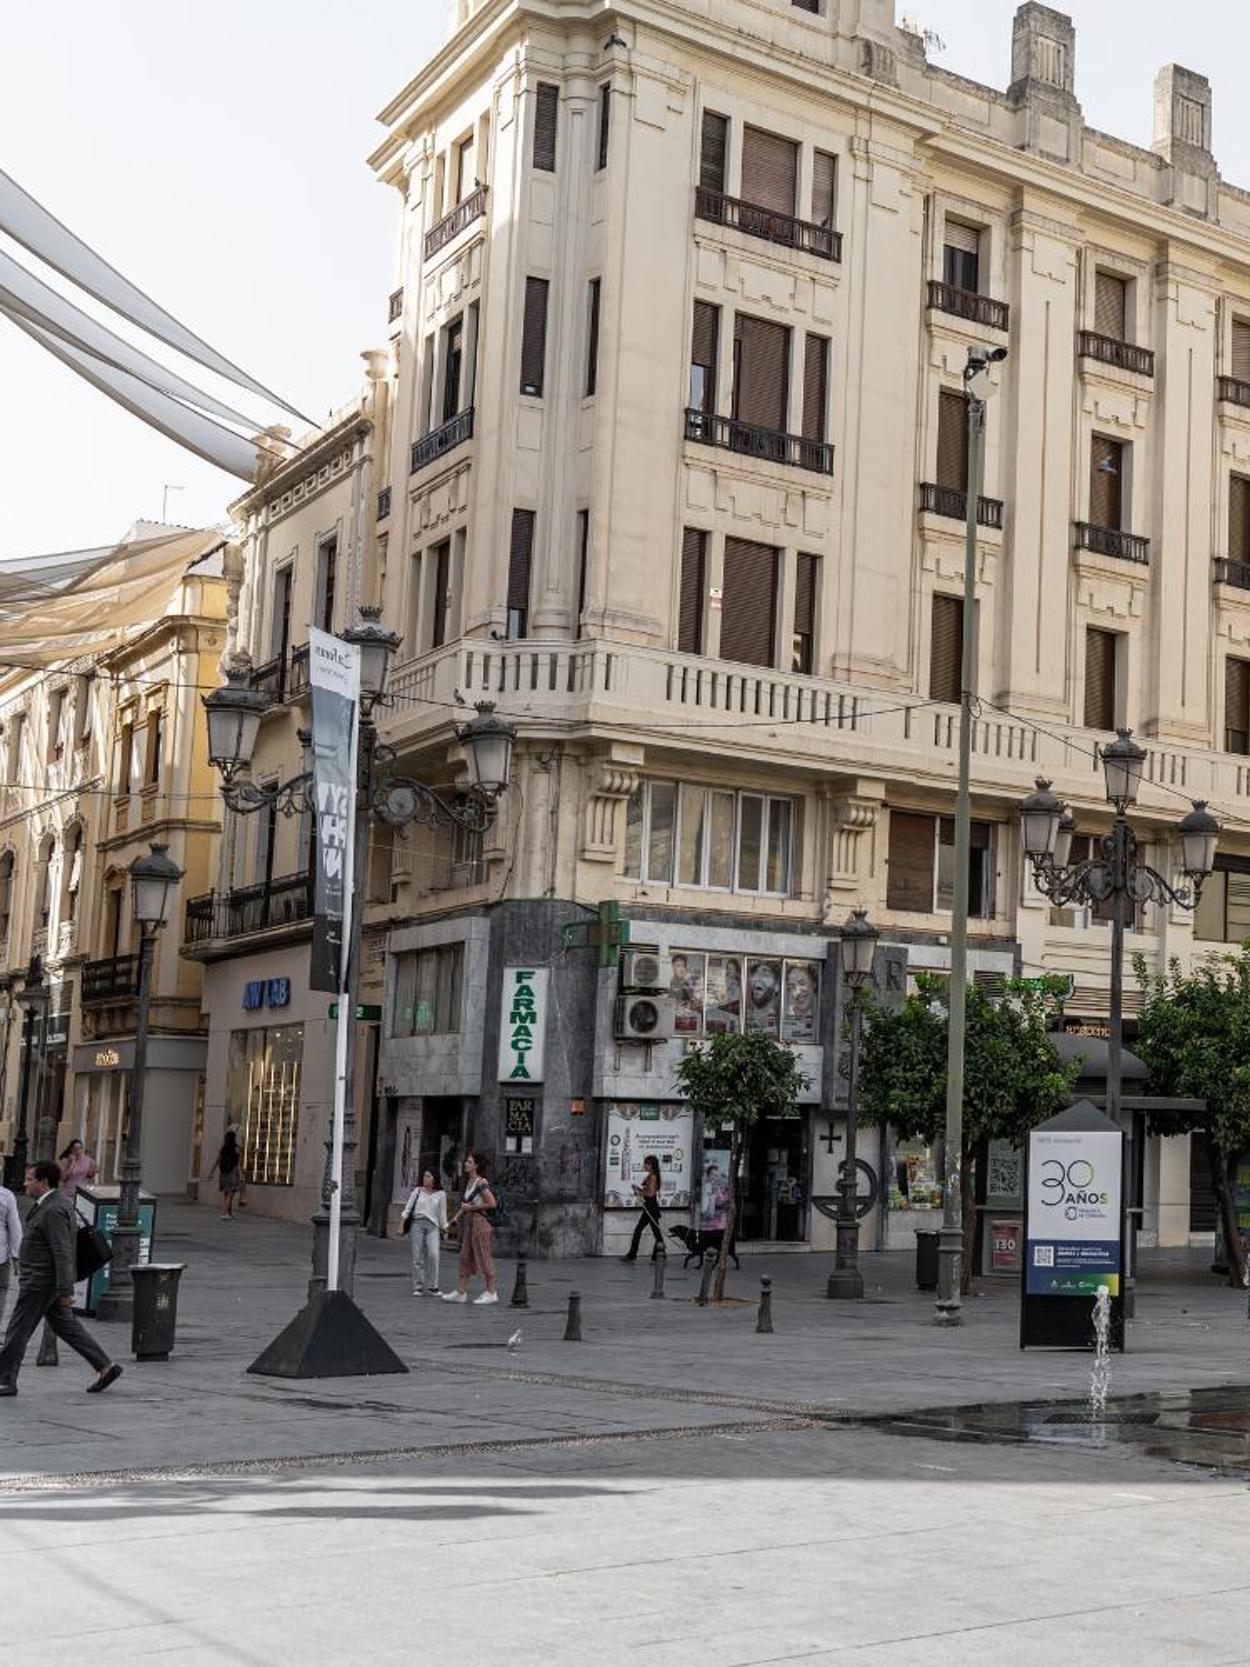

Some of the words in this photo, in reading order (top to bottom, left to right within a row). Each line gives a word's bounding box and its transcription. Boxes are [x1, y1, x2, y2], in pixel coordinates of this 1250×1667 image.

[509, 971, 537, 1079] FARMACIA
[509, 1101, 532, 1112] FAR
[510, 1112, 528, 1121] MA
[508, 1121, 532, 1132] CIA
[1041, 1160, 1094, 1206] 30
[1065, 1189, 1109, 1204] AÑOS
